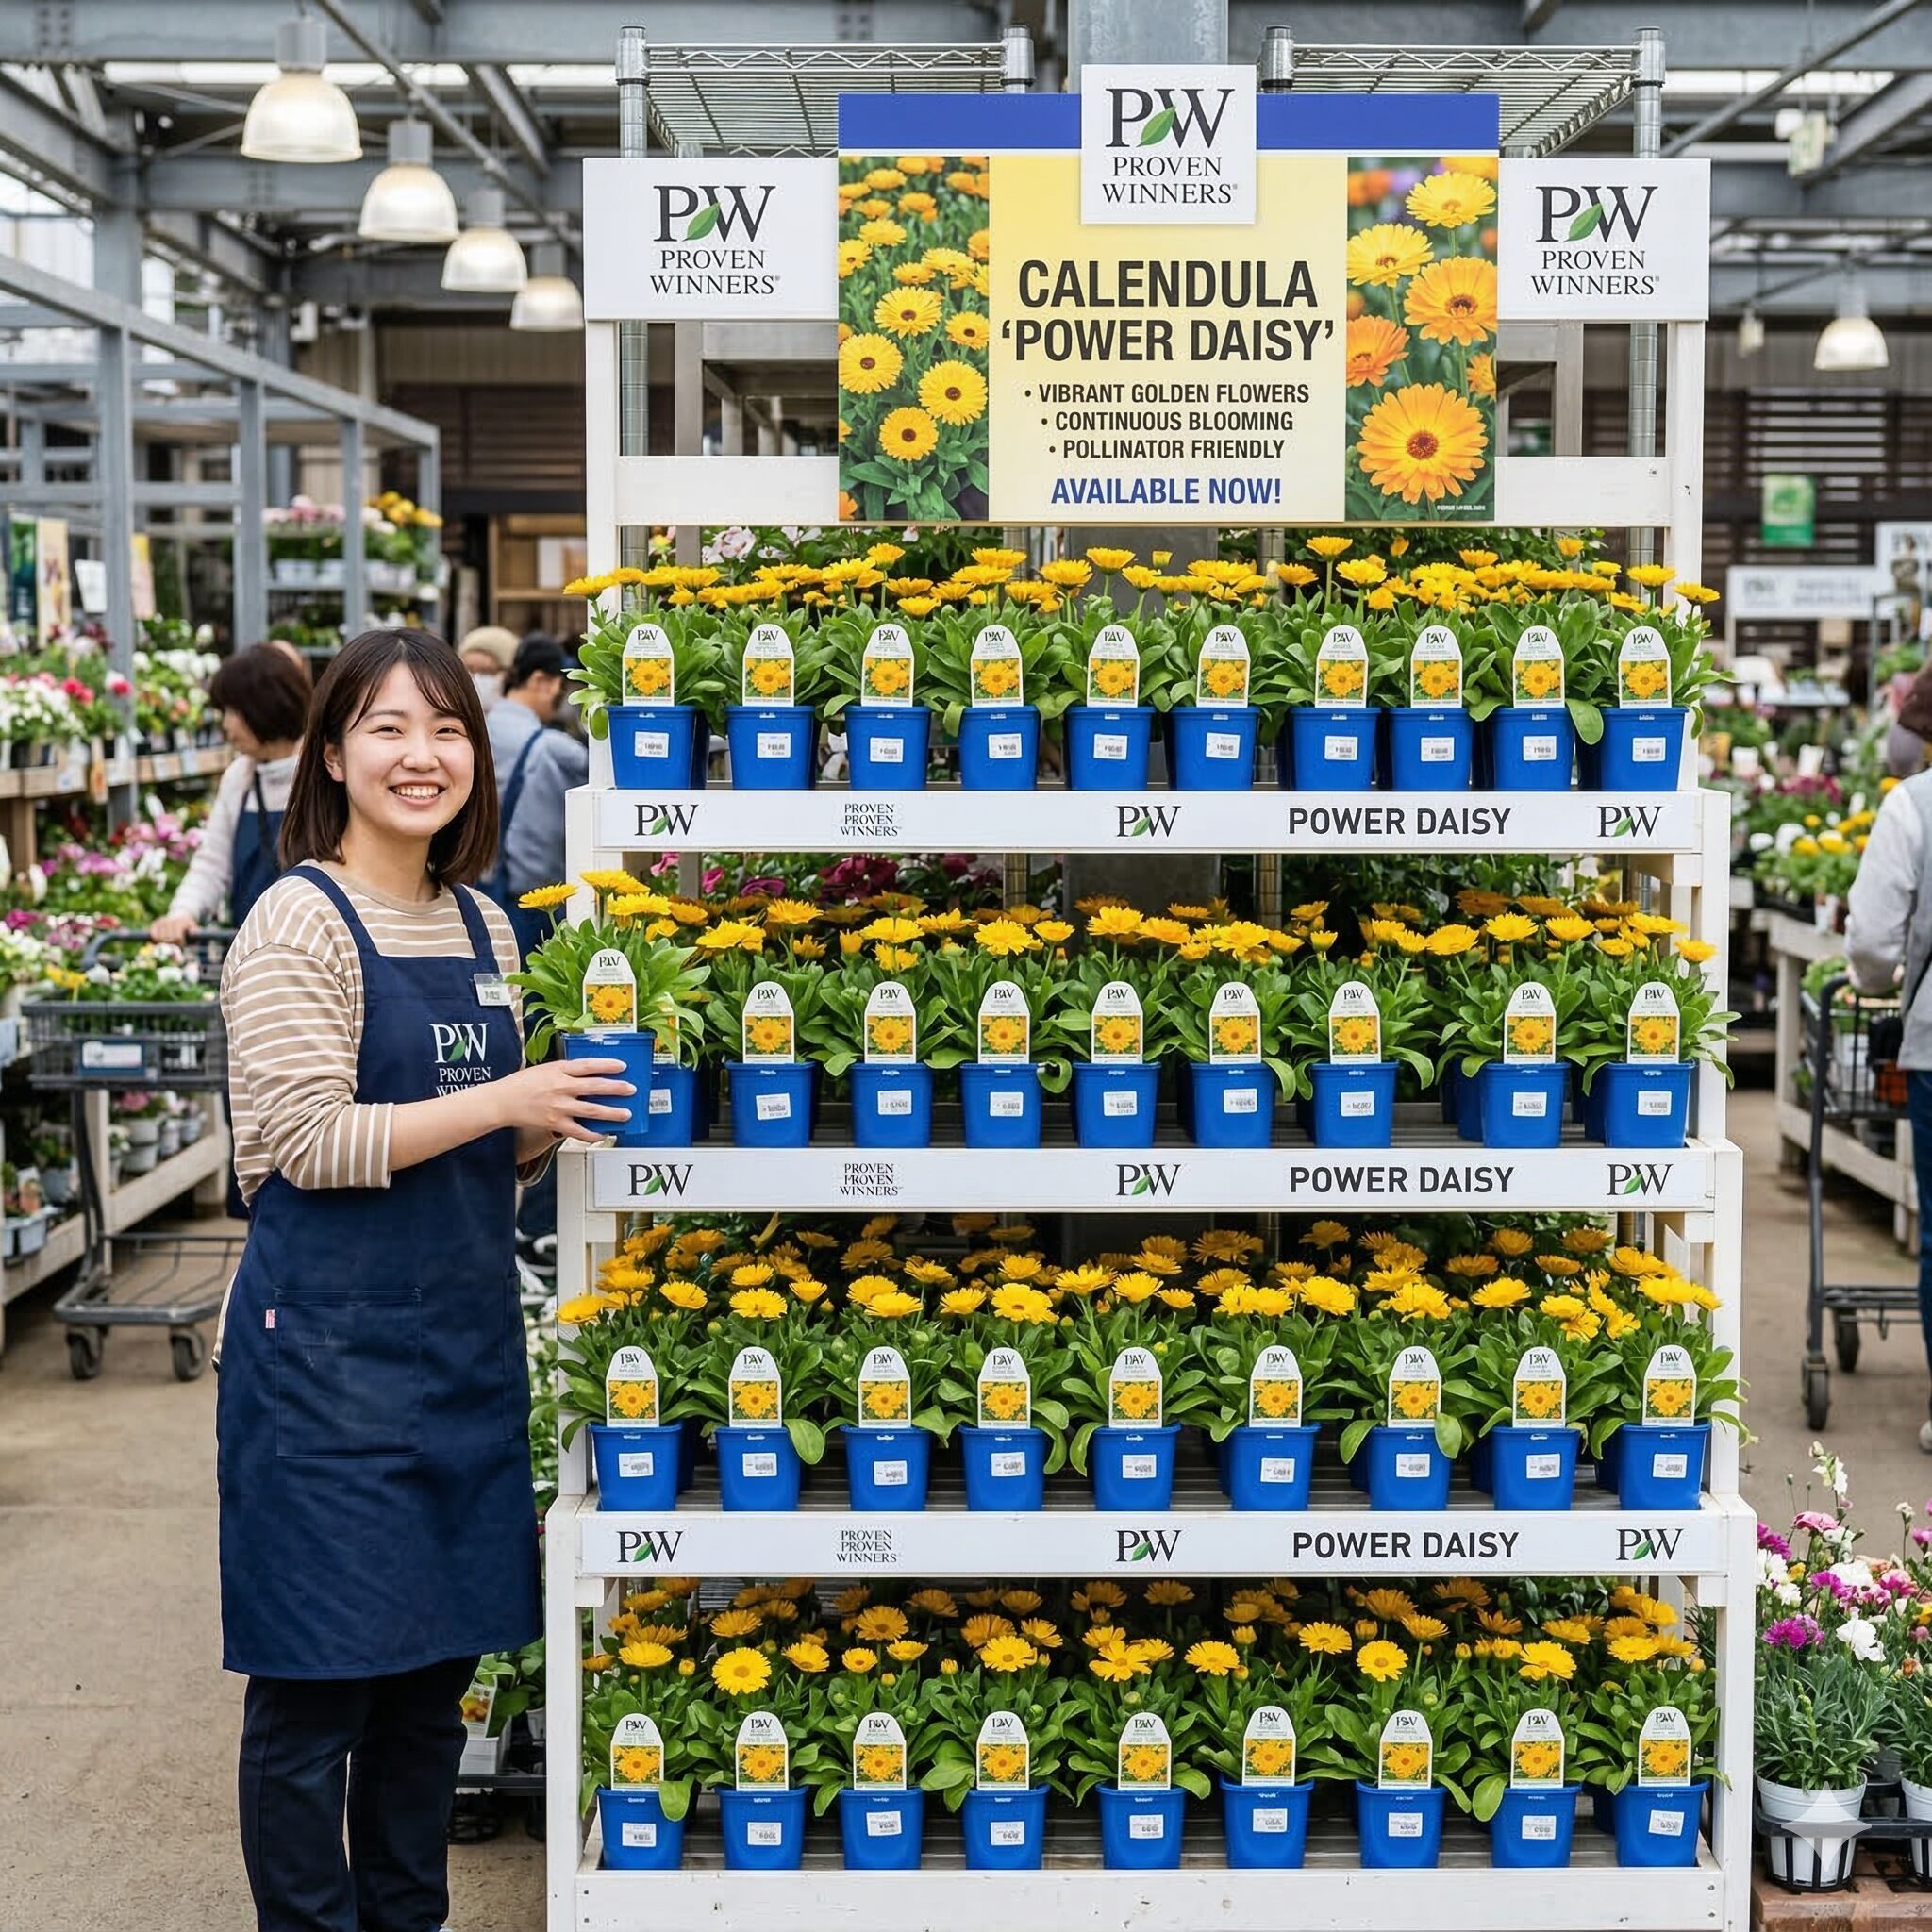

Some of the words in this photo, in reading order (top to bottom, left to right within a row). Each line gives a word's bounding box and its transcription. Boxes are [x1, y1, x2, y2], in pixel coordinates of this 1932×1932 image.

[1106, 89, 1235, 147] PW
[1112, 157, 1222, 176] PROVEN
[653, 186, 775, 242] PW
[1536, 186, 1658, 242] PW
[660, 250, 765, 269] PROVEN
[1543, 251, 1645, 269] PROVEN
[1019, 260, 1318, 308] CALENDULA
[1040, 385, 1124, 403] VIBRANT
[1132, 384, 1208, 403] GOLDEN
[1217, 384, 1309, 403] FLOWERS
[1056, 412, 1181, 431] CONTINUOUS
[1189, 412, 1293, 431] BLOOMING
[1063, 440, 1184, 458] POLLINATOR
[1191, 440, 1285, 458] FRIENDLY
[1051, 478, 1199, 504] AVAILABLE
[1209, 478, 1281, 504] NOW!
[634, 805, 698, 837] PW
[844, 804, 894, 813] PROVEN
[1116, 805, 1181, 838] PW
[1289, 808, 1405, 835] POWER
[1417, 808, 1511, 835] DAISY
[1597, 805, 1661, 838] PW
[428, 1023, 489, 1063] PW
[439, 1066, 491, 1083] PROVEN
[627, 1164, 694, 1196] PW
[844, 1163, 894, 1174] PROVEN
[1116, 1164, 1181, 1196] PW
[1291, 1166, 1408, 1193] POWER
[1420, 1166, 1514, 1193] DAISY
[1607, 1164, 1674, 1196] PW
[616, 1531, 683, 1563] PW
[841, 1530, 891, 1540] PROVEN
[1116, 1529, 1181, 1561] PW
[1293, 1532, 1412, 1558] POWER
[1424, 1532, 1519, 1558] DAISY
[1617, 1528, 1683, 1560] PW
